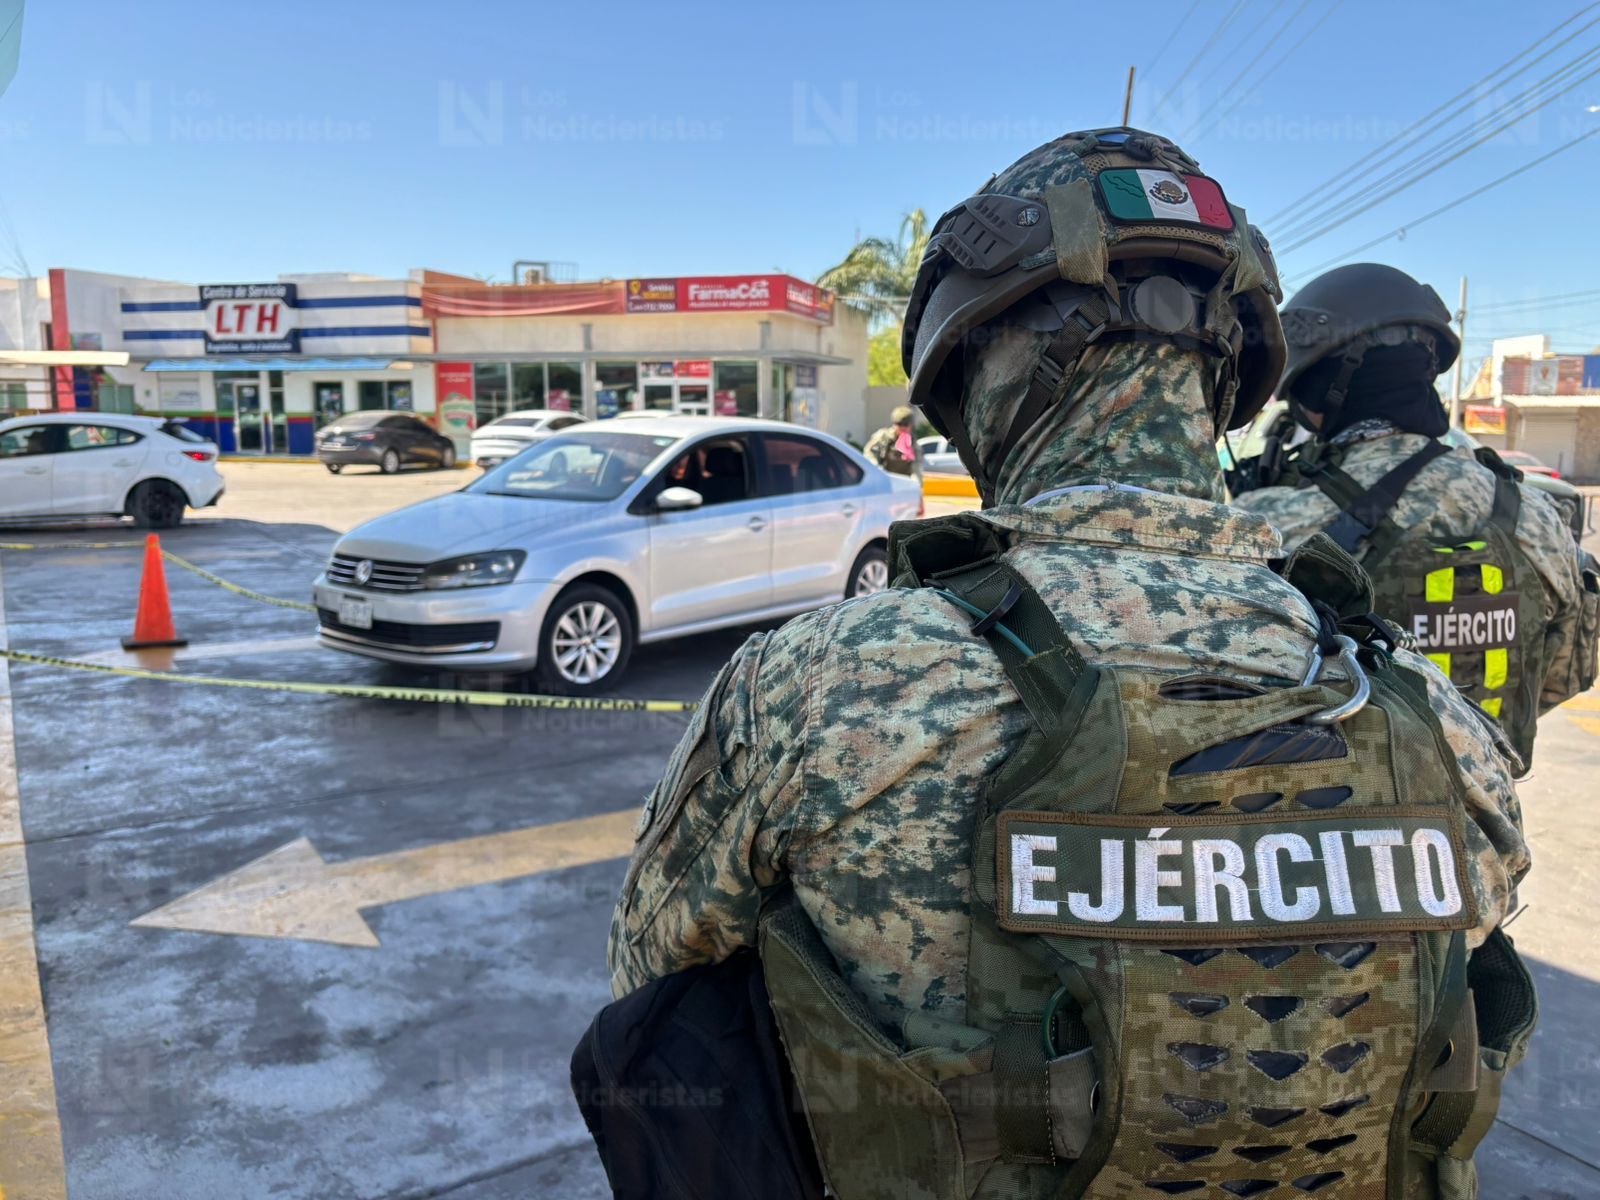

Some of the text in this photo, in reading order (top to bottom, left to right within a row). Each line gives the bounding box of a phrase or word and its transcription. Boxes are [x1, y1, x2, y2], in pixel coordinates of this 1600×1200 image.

[216, 304, 280, 333] LTH
[1413, 607, 1516, 647] EJÉRCITO
[1011, 827, 1462, 922] EJÉRCITO
